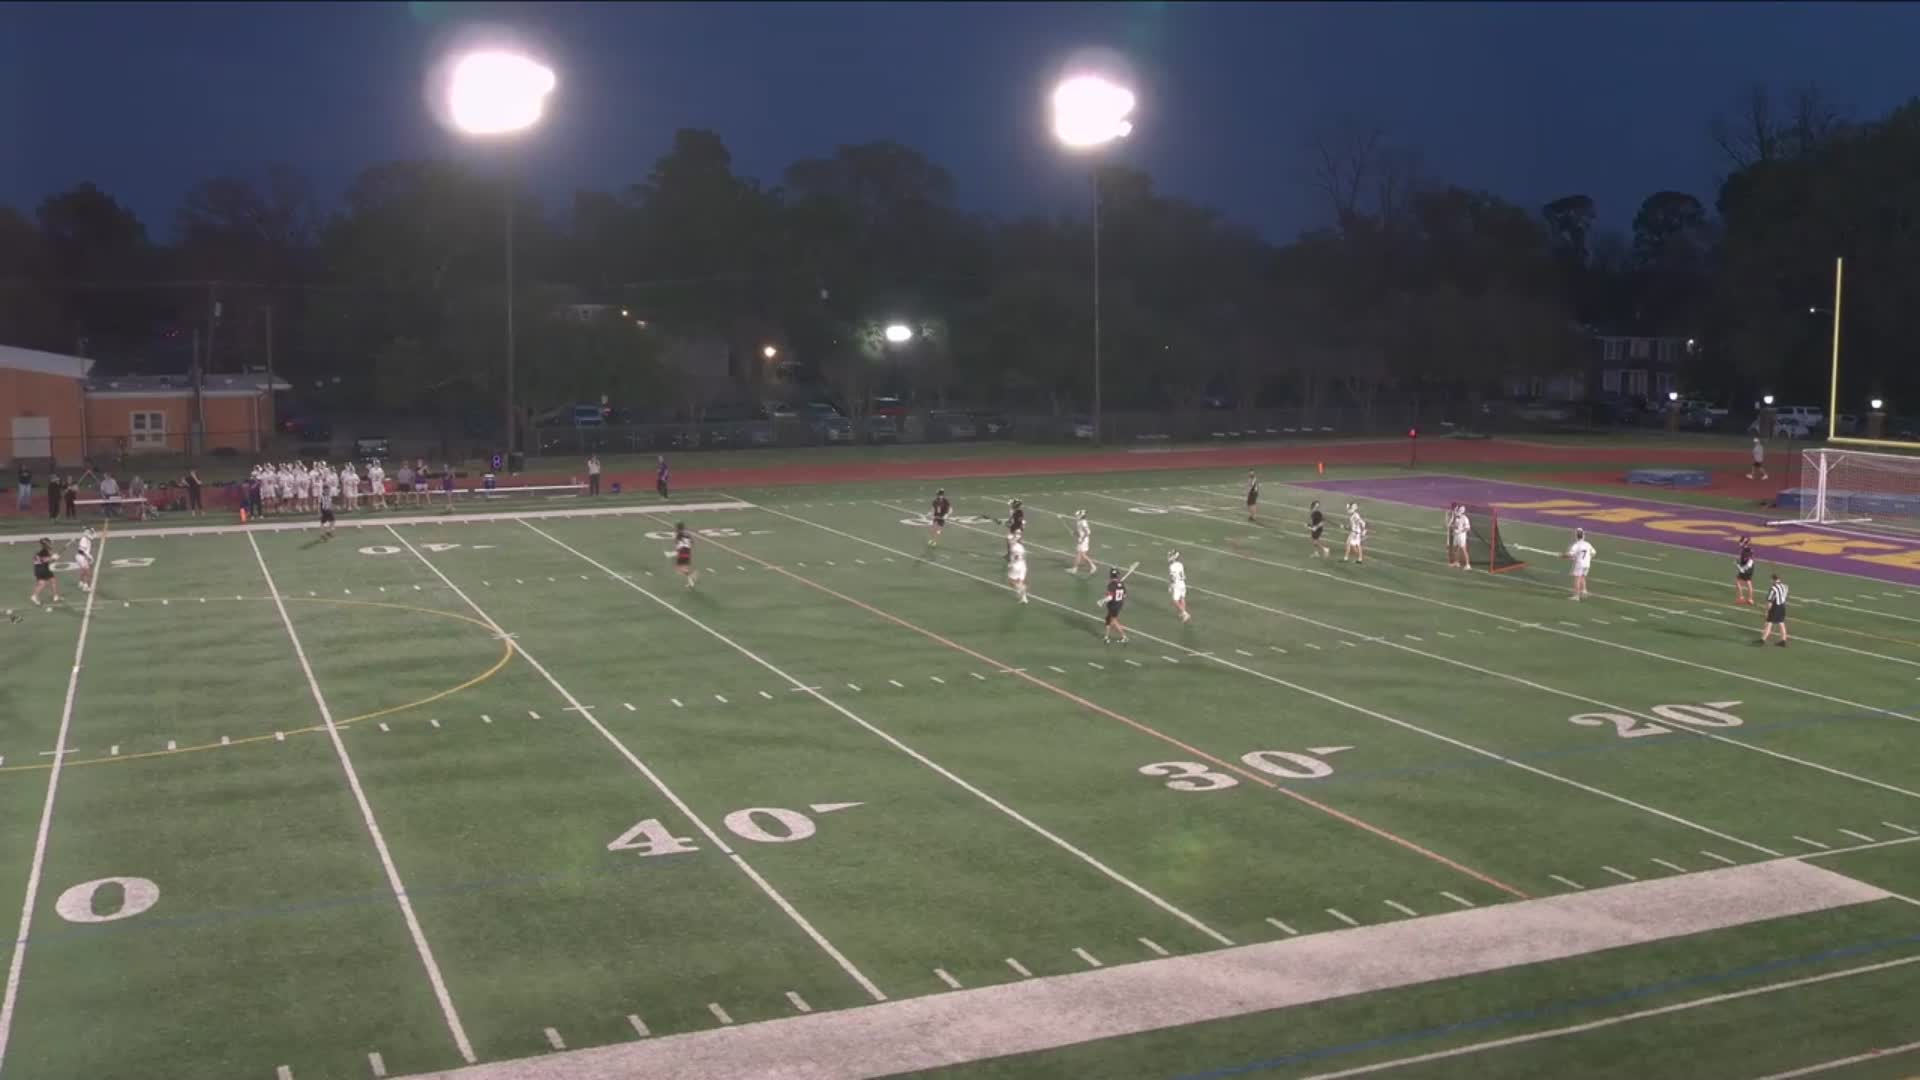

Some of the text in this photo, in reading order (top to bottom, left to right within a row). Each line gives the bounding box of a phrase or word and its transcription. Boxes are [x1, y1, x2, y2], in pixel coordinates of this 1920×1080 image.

[1568, 704, 1744, 738] 20
[1138, 751, 1334, 791] 30
[607, 807, 817, 857] 40
